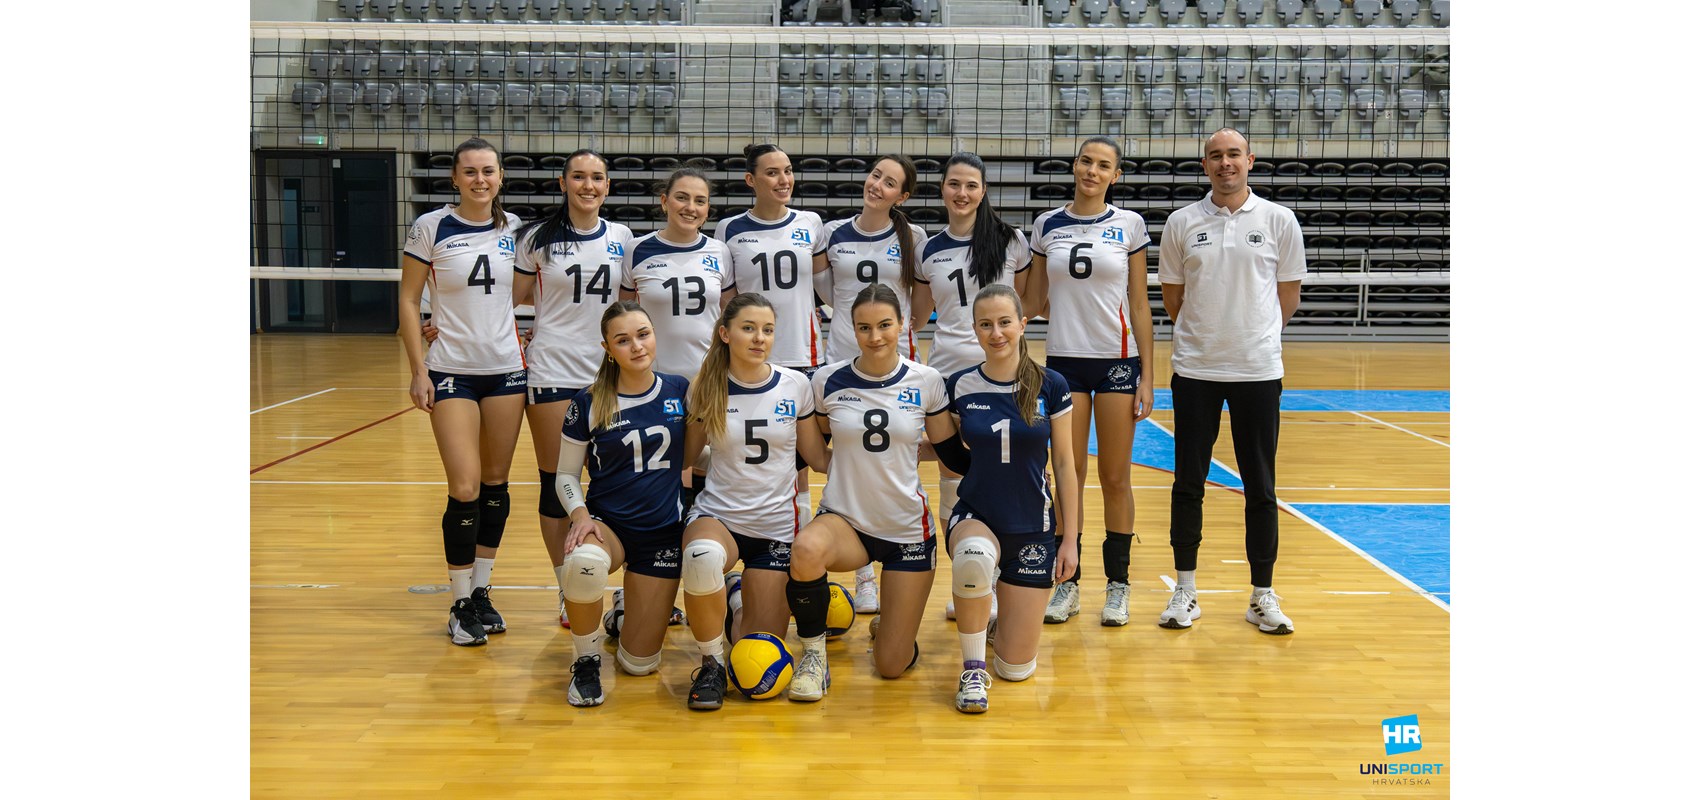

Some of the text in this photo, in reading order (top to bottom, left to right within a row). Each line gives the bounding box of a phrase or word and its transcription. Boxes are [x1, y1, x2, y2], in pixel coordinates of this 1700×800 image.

[501, 236, 514, 250] ST
[794, 229, 808, 241] ST
[1105, 228, 1121, 240] ST
[608, 242, 621, 255] ST
[1069, 243, 1093, 279] 6
[468, 255, 495, 294] 4
[705, 255, 718, 269] ST
[751, 250, 798, 291] 10
[857, 260, 878, 285] 9
[565, 264, 612, 304] 14
[662, 276, 706, 316] 13
[437, 377, 456, 393] 4
[901, 388, 919, 403] ST
[663, 399, 680, 413] ST
[777, 399, 794, 415] ST
[745, 419, 768, 464] 5
[863, 409, 890, 452] 8
[991, 419, 1010, 463] 1
[621, 425, 671, 472] 12
